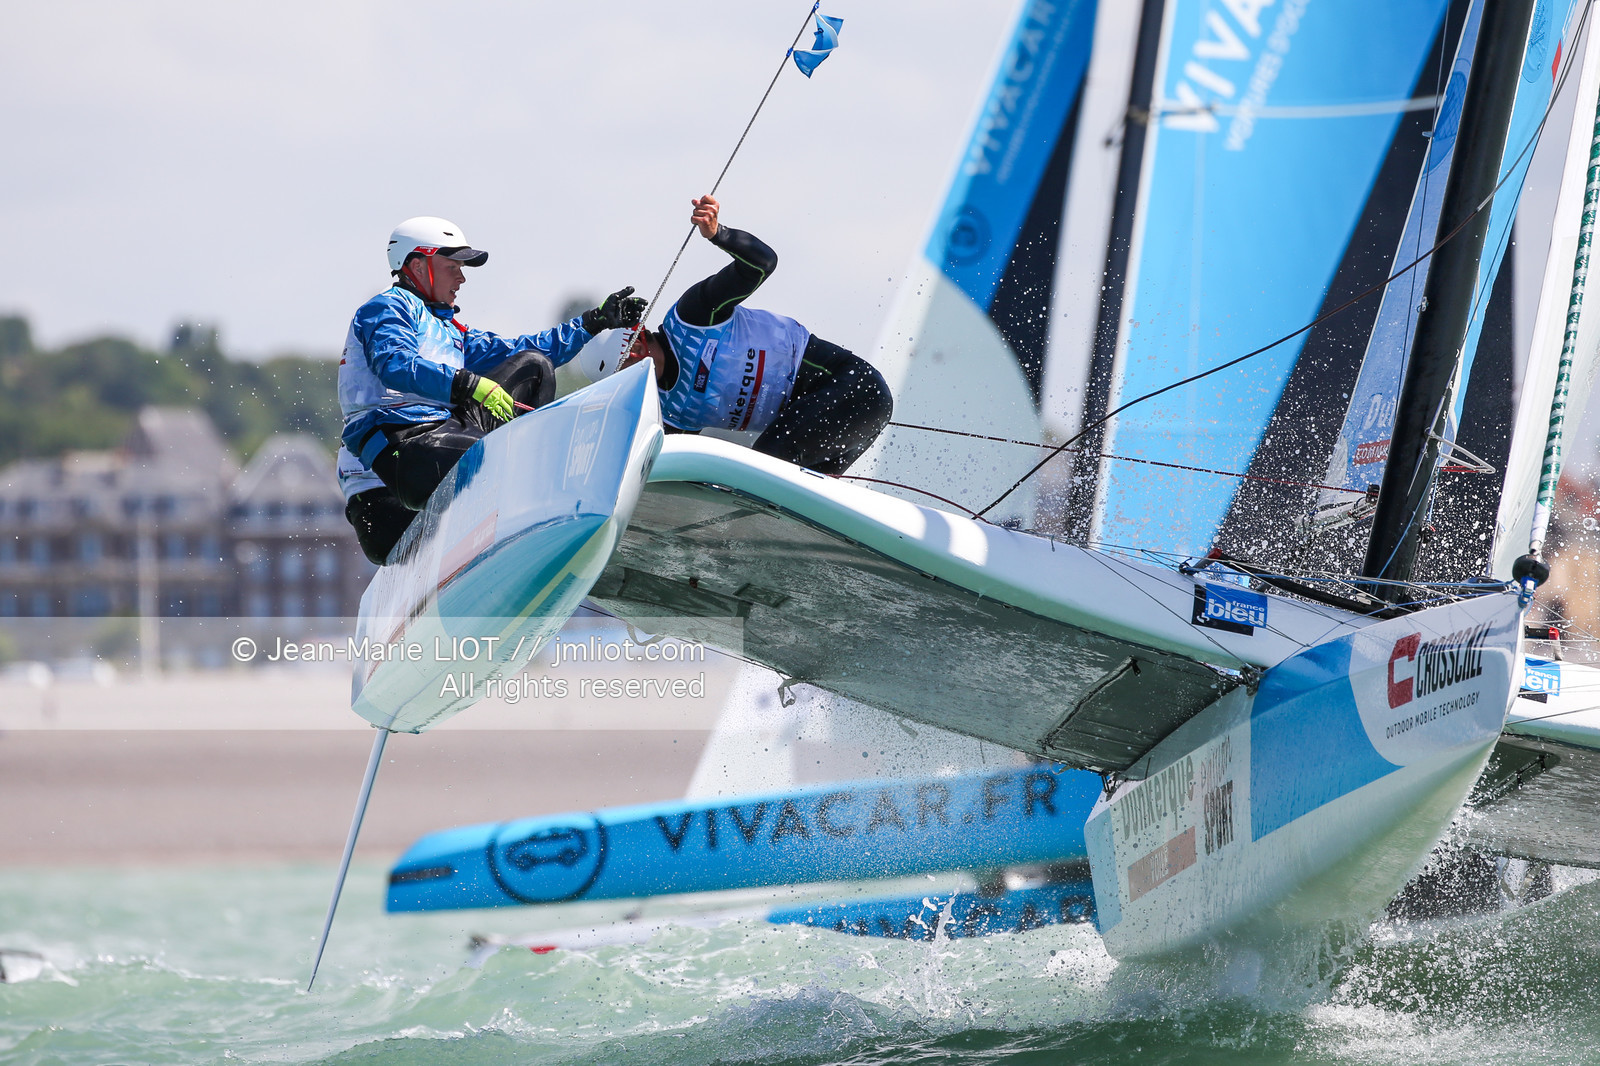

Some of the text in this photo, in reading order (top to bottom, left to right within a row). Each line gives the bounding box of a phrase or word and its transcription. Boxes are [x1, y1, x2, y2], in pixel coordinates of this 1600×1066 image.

[728, 347, 756, 431] unkerque
[1207, 598, 1265, 627] bleu
[1232, 600, 1265, 612] france
[1416, 620, 1493, 698] CROSSCALL
[1385, 691, 1481, 740] OUTDOOR MOBILE TECHNOLOGY
[654, 771, 1059, 853] VIVACAR.FR
[1203, 779, 1235, 857] SPORT
